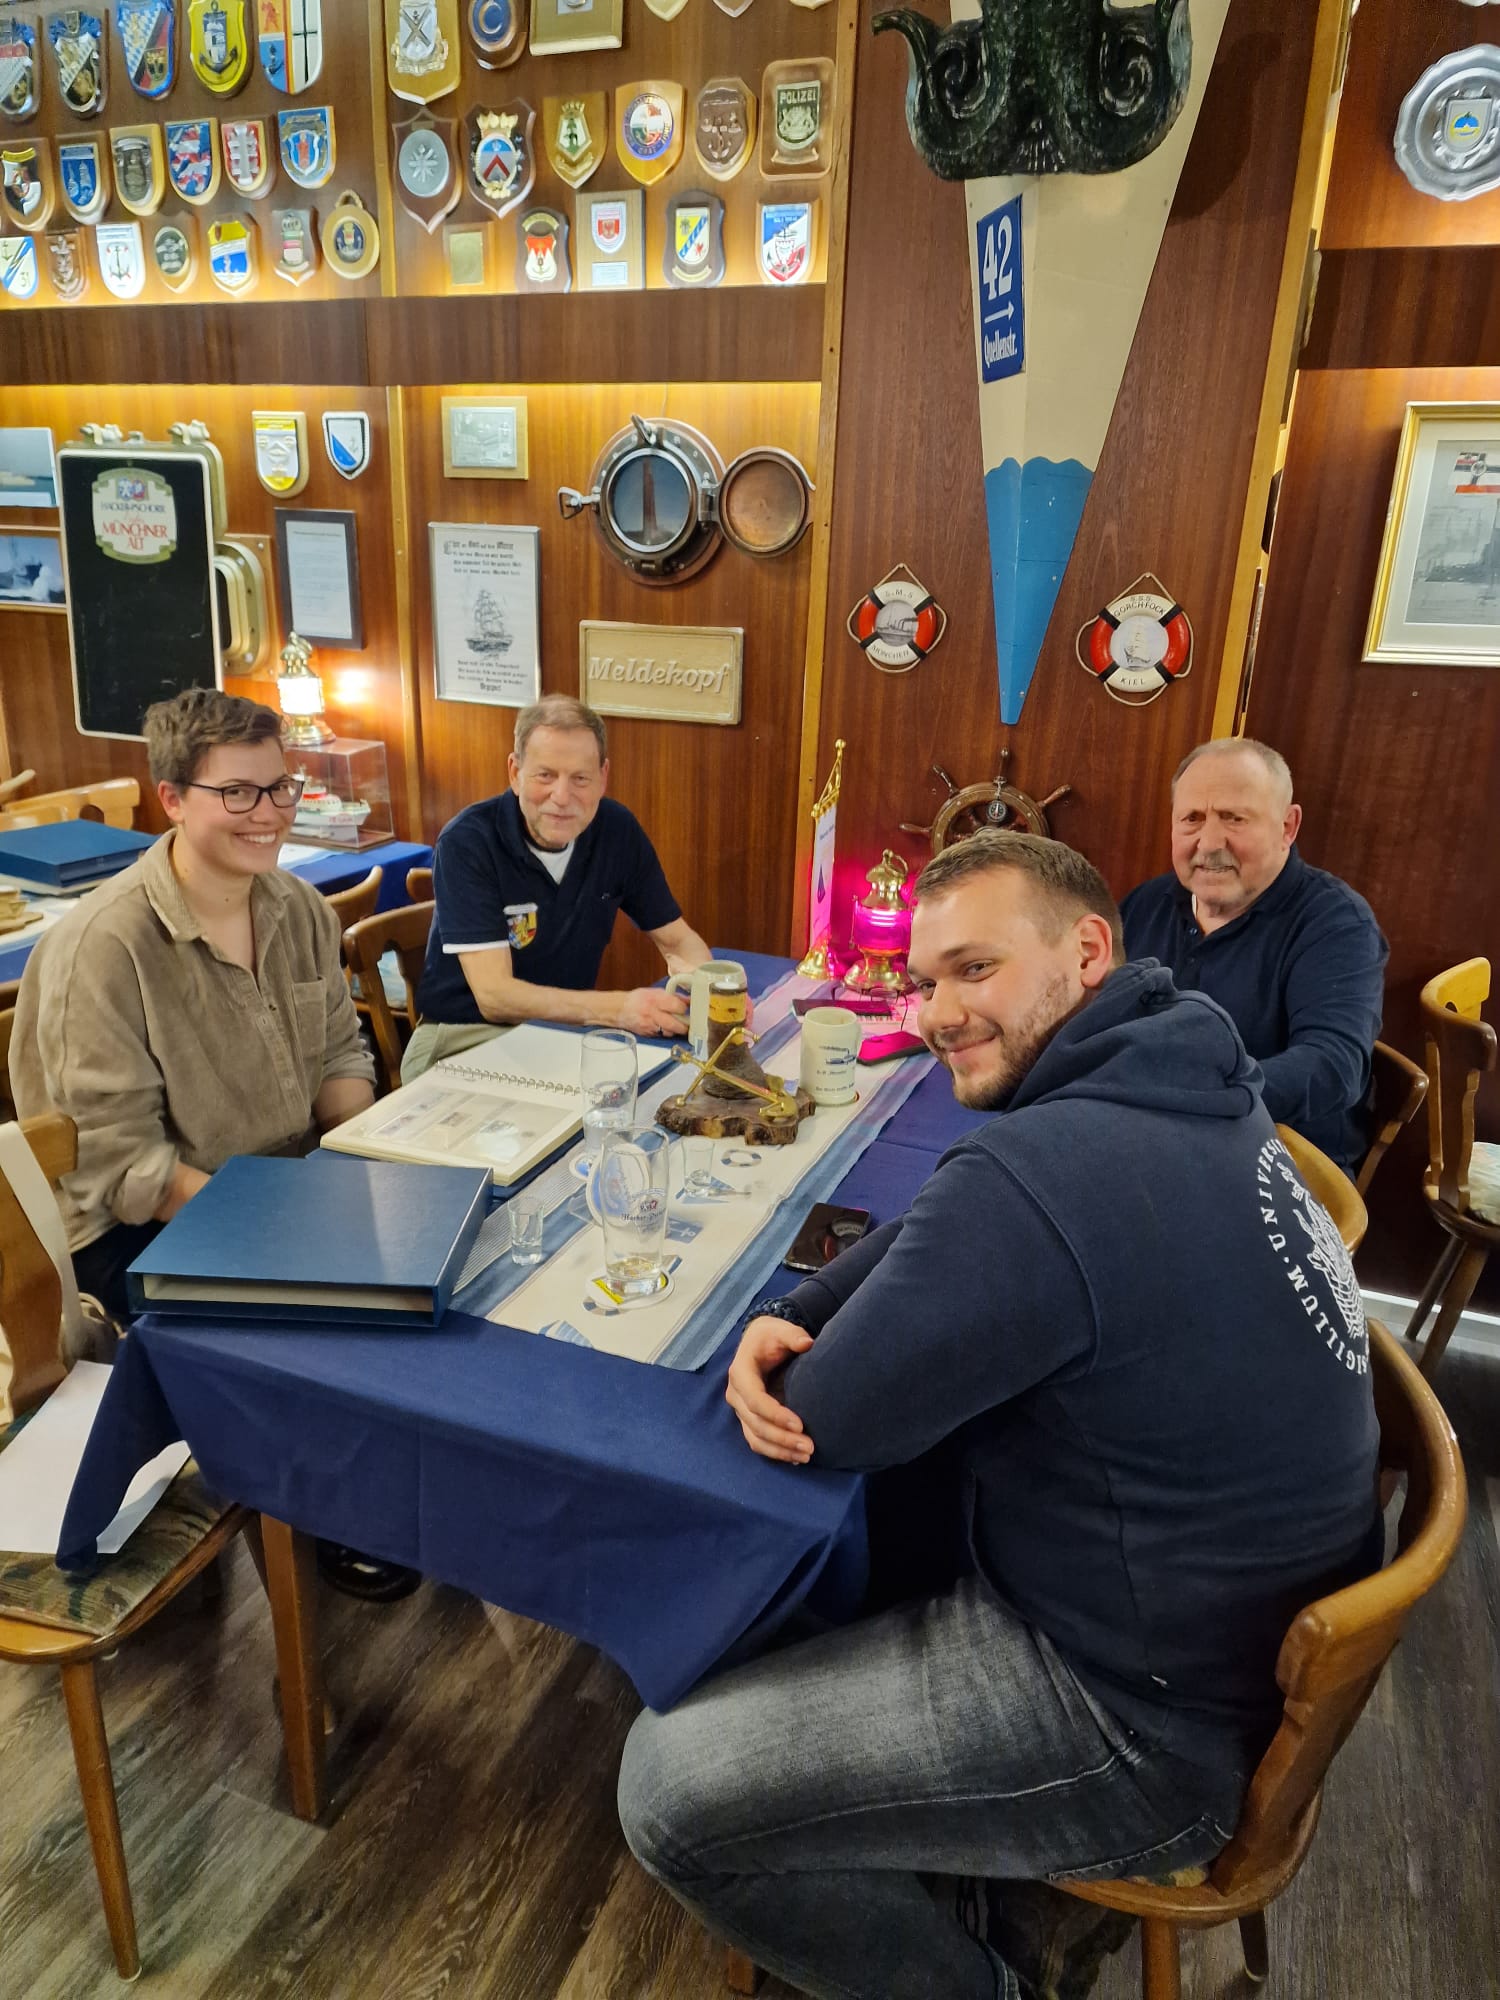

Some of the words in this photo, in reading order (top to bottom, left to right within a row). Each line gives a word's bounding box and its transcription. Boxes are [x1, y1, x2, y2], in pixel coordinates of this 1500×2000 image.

[779, 89, 818, 104] POLIZEI
[983, 214, 1013, 301] 42
[984, 327, 1018, 369] Quellenstr.
[588, 656, 732, 693] Meldekopf
[1120, 677, 1146, 686] KIEL
